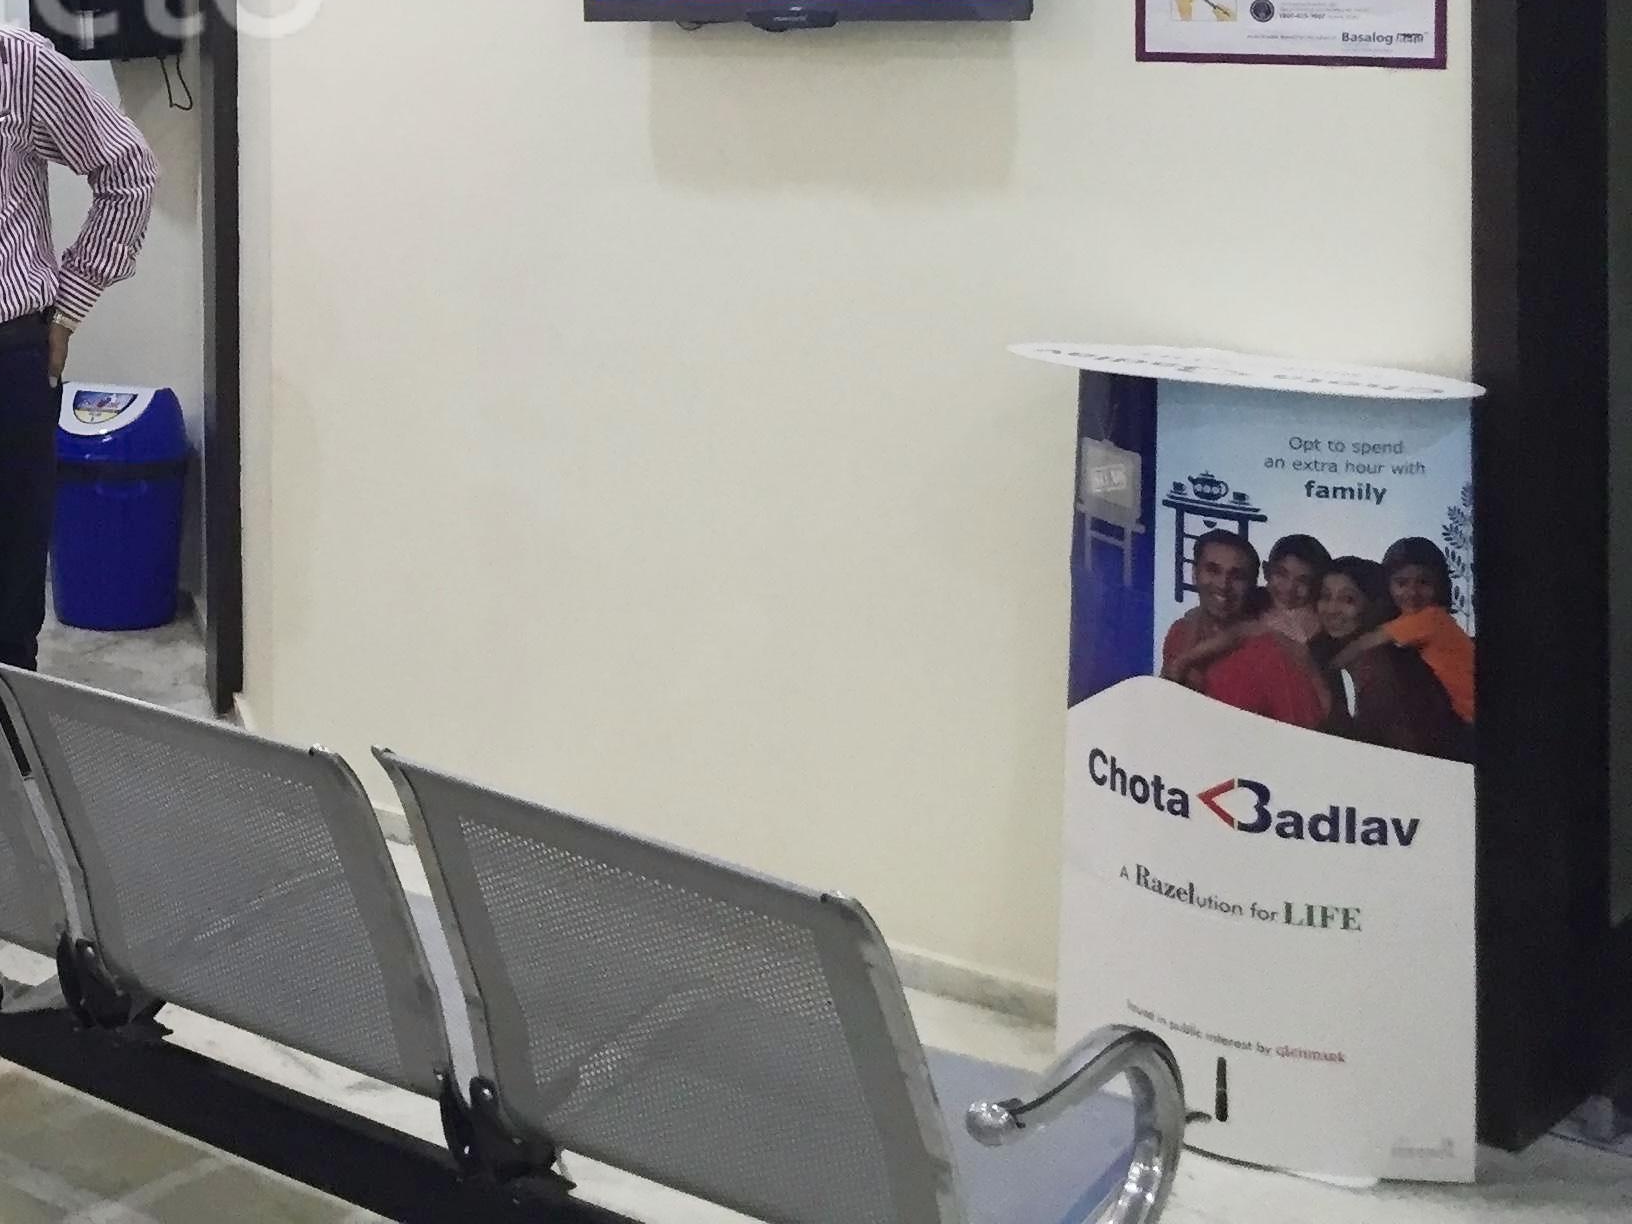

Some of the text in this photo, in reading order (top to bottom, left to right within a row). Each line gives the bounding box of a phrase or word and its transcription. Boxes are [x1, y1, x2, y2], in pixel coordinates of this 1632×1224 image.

[1342, 32, 1393, 46] Basalog
[1289, 436, 1404, 456] Opt to spend
[1264, 457, 1426, 476] an extra hour with
[1304, 480, 1387, 506] family
[1088, 747, 1191, 819] Chota
[1120, 863, 1363, 932] A Razelution for LIFE
[1205, 1032, 1253, 1050] interest
[1256, 1041, 1272, 1056] by
